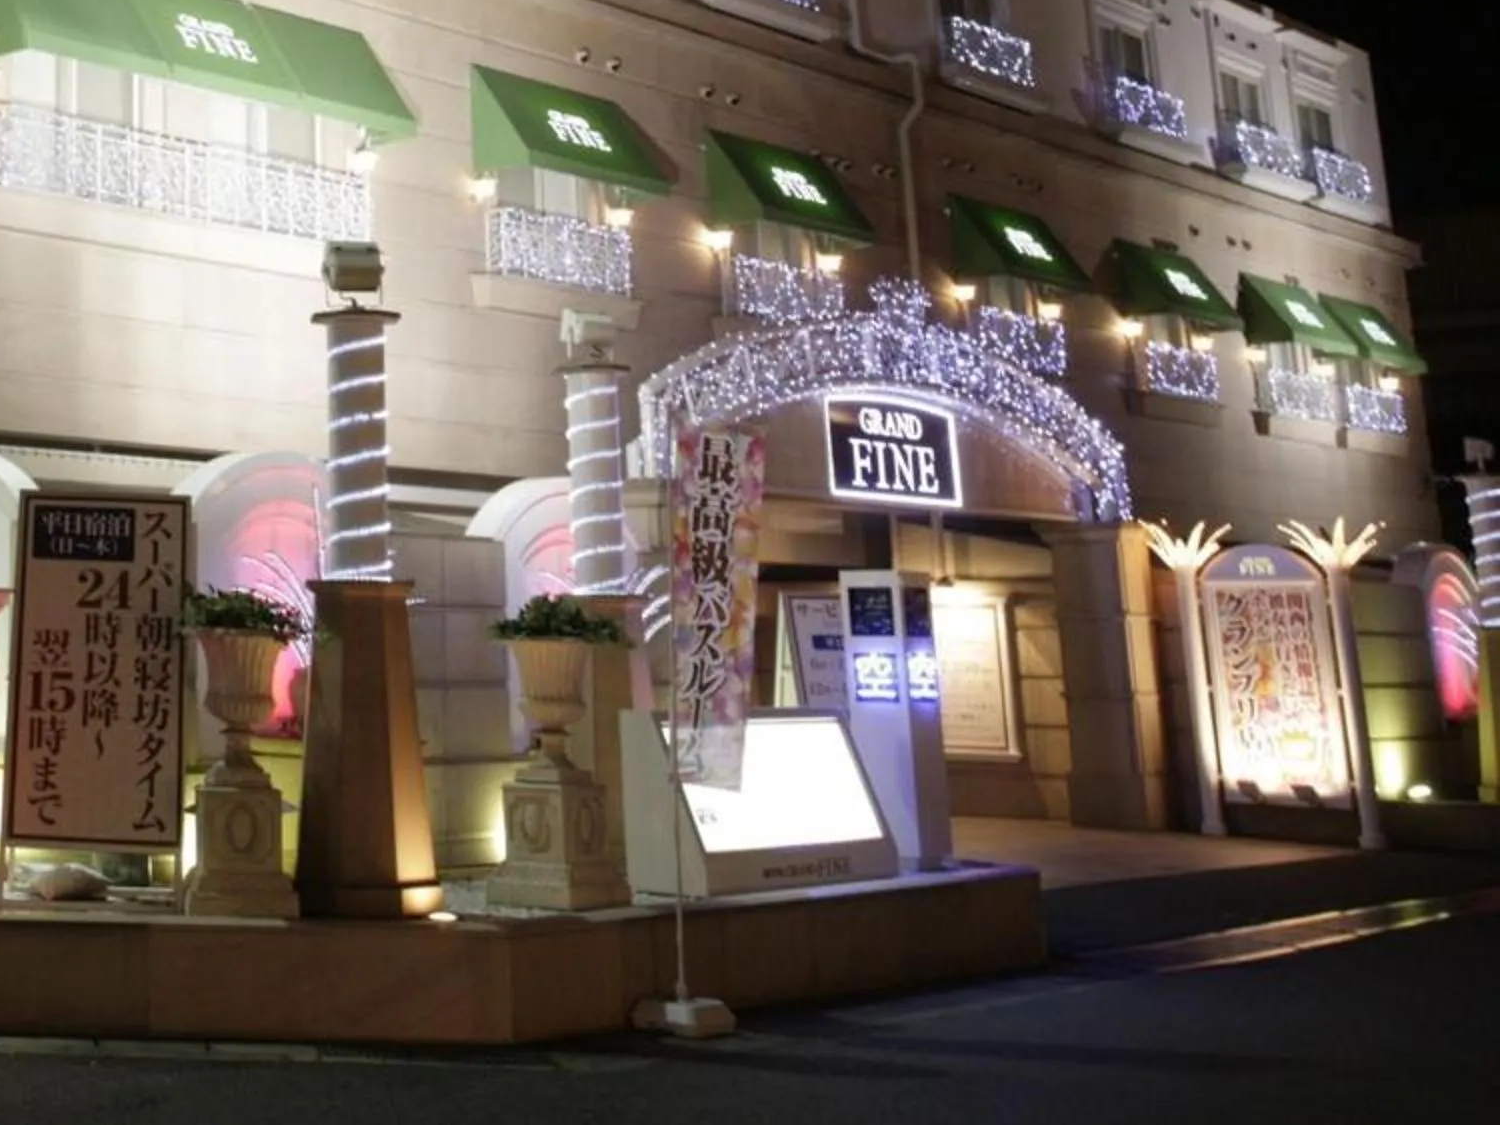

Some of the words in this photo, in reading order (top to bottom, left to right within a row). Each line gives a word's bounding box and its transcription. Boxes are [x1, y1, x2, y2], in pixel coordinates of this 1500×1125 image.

[174, 23, 258, 64] FINE
[859, 406, 923, 440] GRAND
[848, 436, 940, 494] FINE
[41, 511, 131, 537] 平日宿泊
[132, 511, 175, 833] スーパー朝寝坊タイム
[27, 628, 76, 826] 翌15時まで
